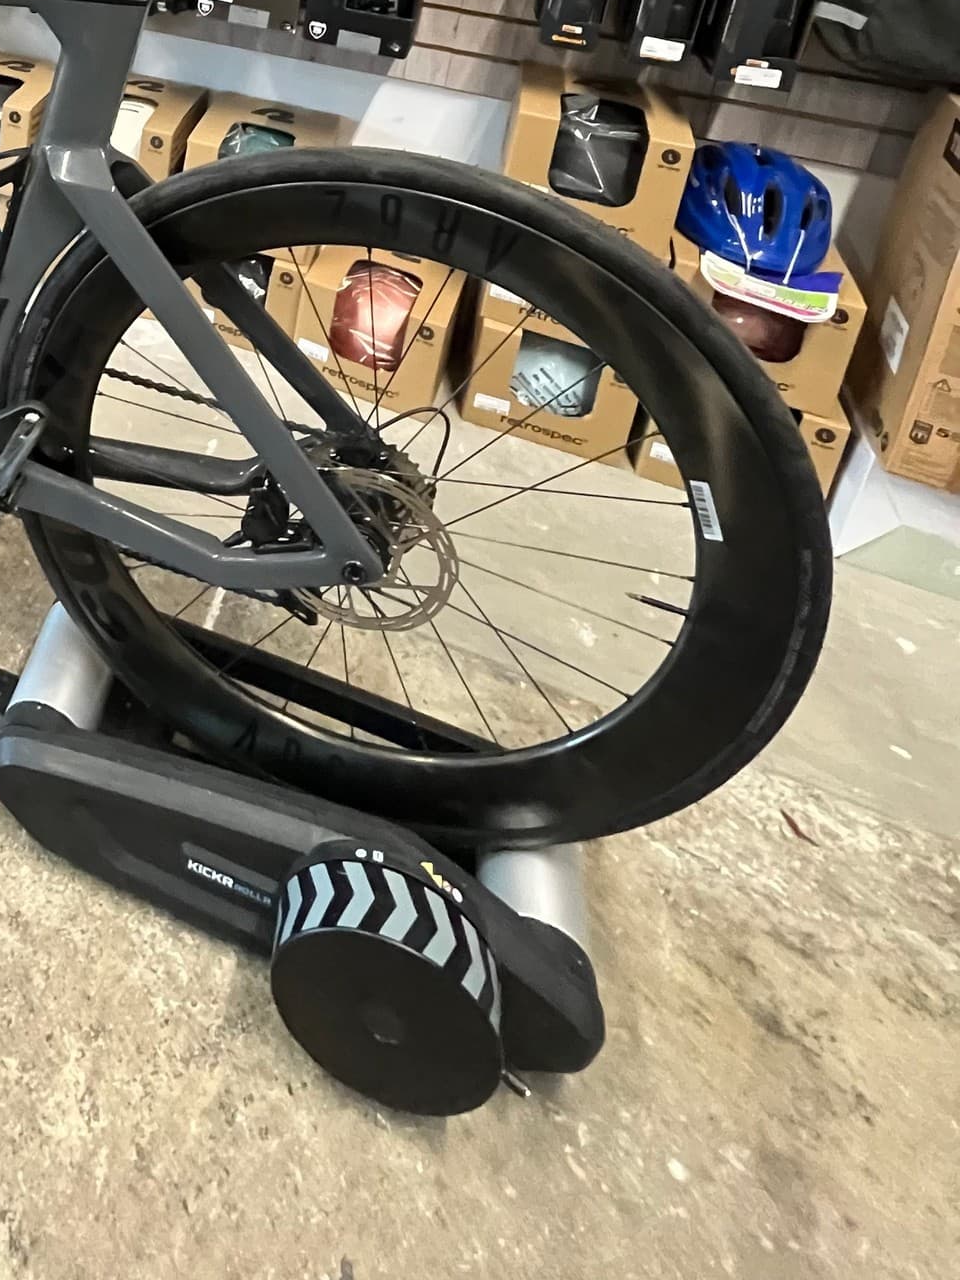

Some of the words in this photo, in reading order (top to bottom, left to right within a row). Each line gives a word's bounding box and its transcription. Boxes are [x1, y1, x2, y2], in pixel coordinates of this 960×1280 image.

[322, 365, 397, 399] retrospec
[500, 414, 585, 447] retrospec
[187, 859, 234, 888] KICKR
